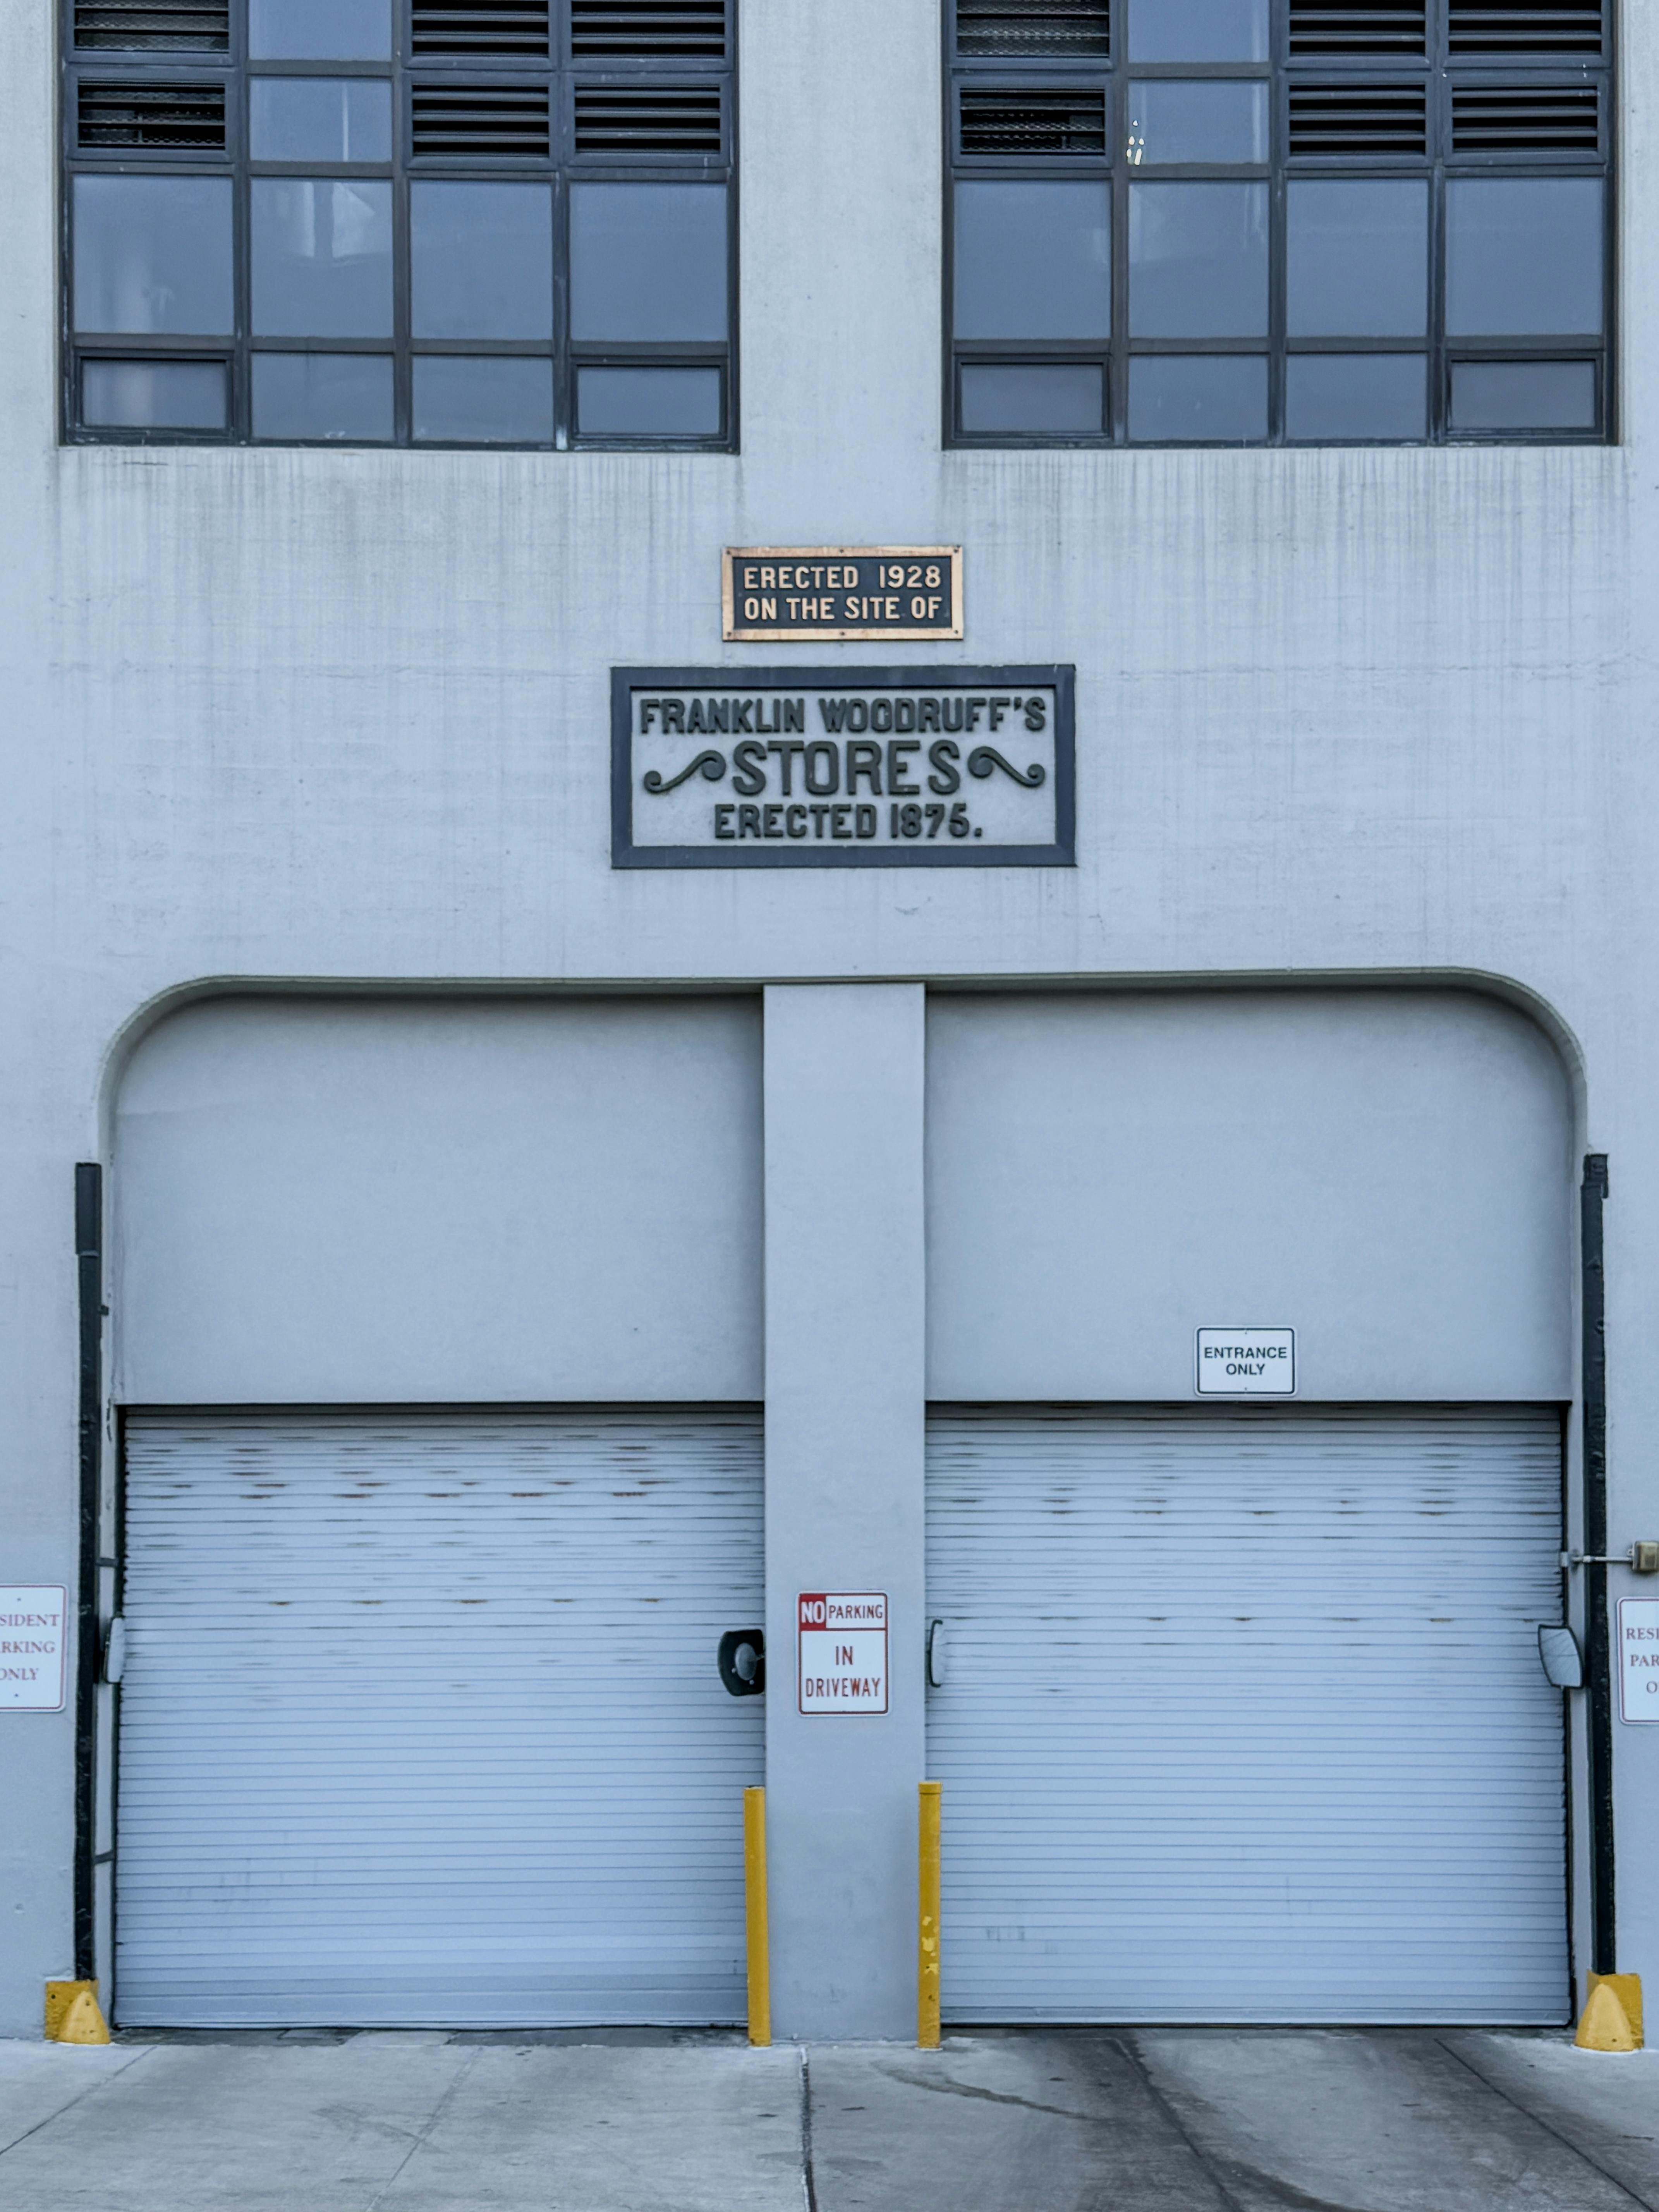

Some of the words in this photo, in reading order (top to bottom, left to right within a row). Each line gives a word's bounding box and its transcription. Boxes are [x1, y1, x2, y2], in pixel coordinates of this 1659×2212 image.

[744, 566, 858, 589] ERECTED
[879, 565, 941, 589] 1928
[744, 597, 776, 620] ON
[786, 598, 835, 620] THE
[844, 597, 900, 619] SITE
[911, 596, 942, 619] OF
[640, 698, 804, 733] FRANKLIN
[819, 696, 1046, 732] WOODRUFF'S
[732, 740, 961, 795] STORES
[714, 804, 877, 838] ERECTED
[891, 803, 982, 838] 1875.
[1204, 1347, 1288, 1358] ENTRANCE
[1226, 1364, 1265, 1375] ONLY
[801, 1601, 825, 1623] NO
[828, 1605, 883, 1619] PARKING
[0, 1641, 55, 1653] RKING
[836, 1646, 853, 1665] IN
[805, 1678, 881, 1697] DRIVEWAY
